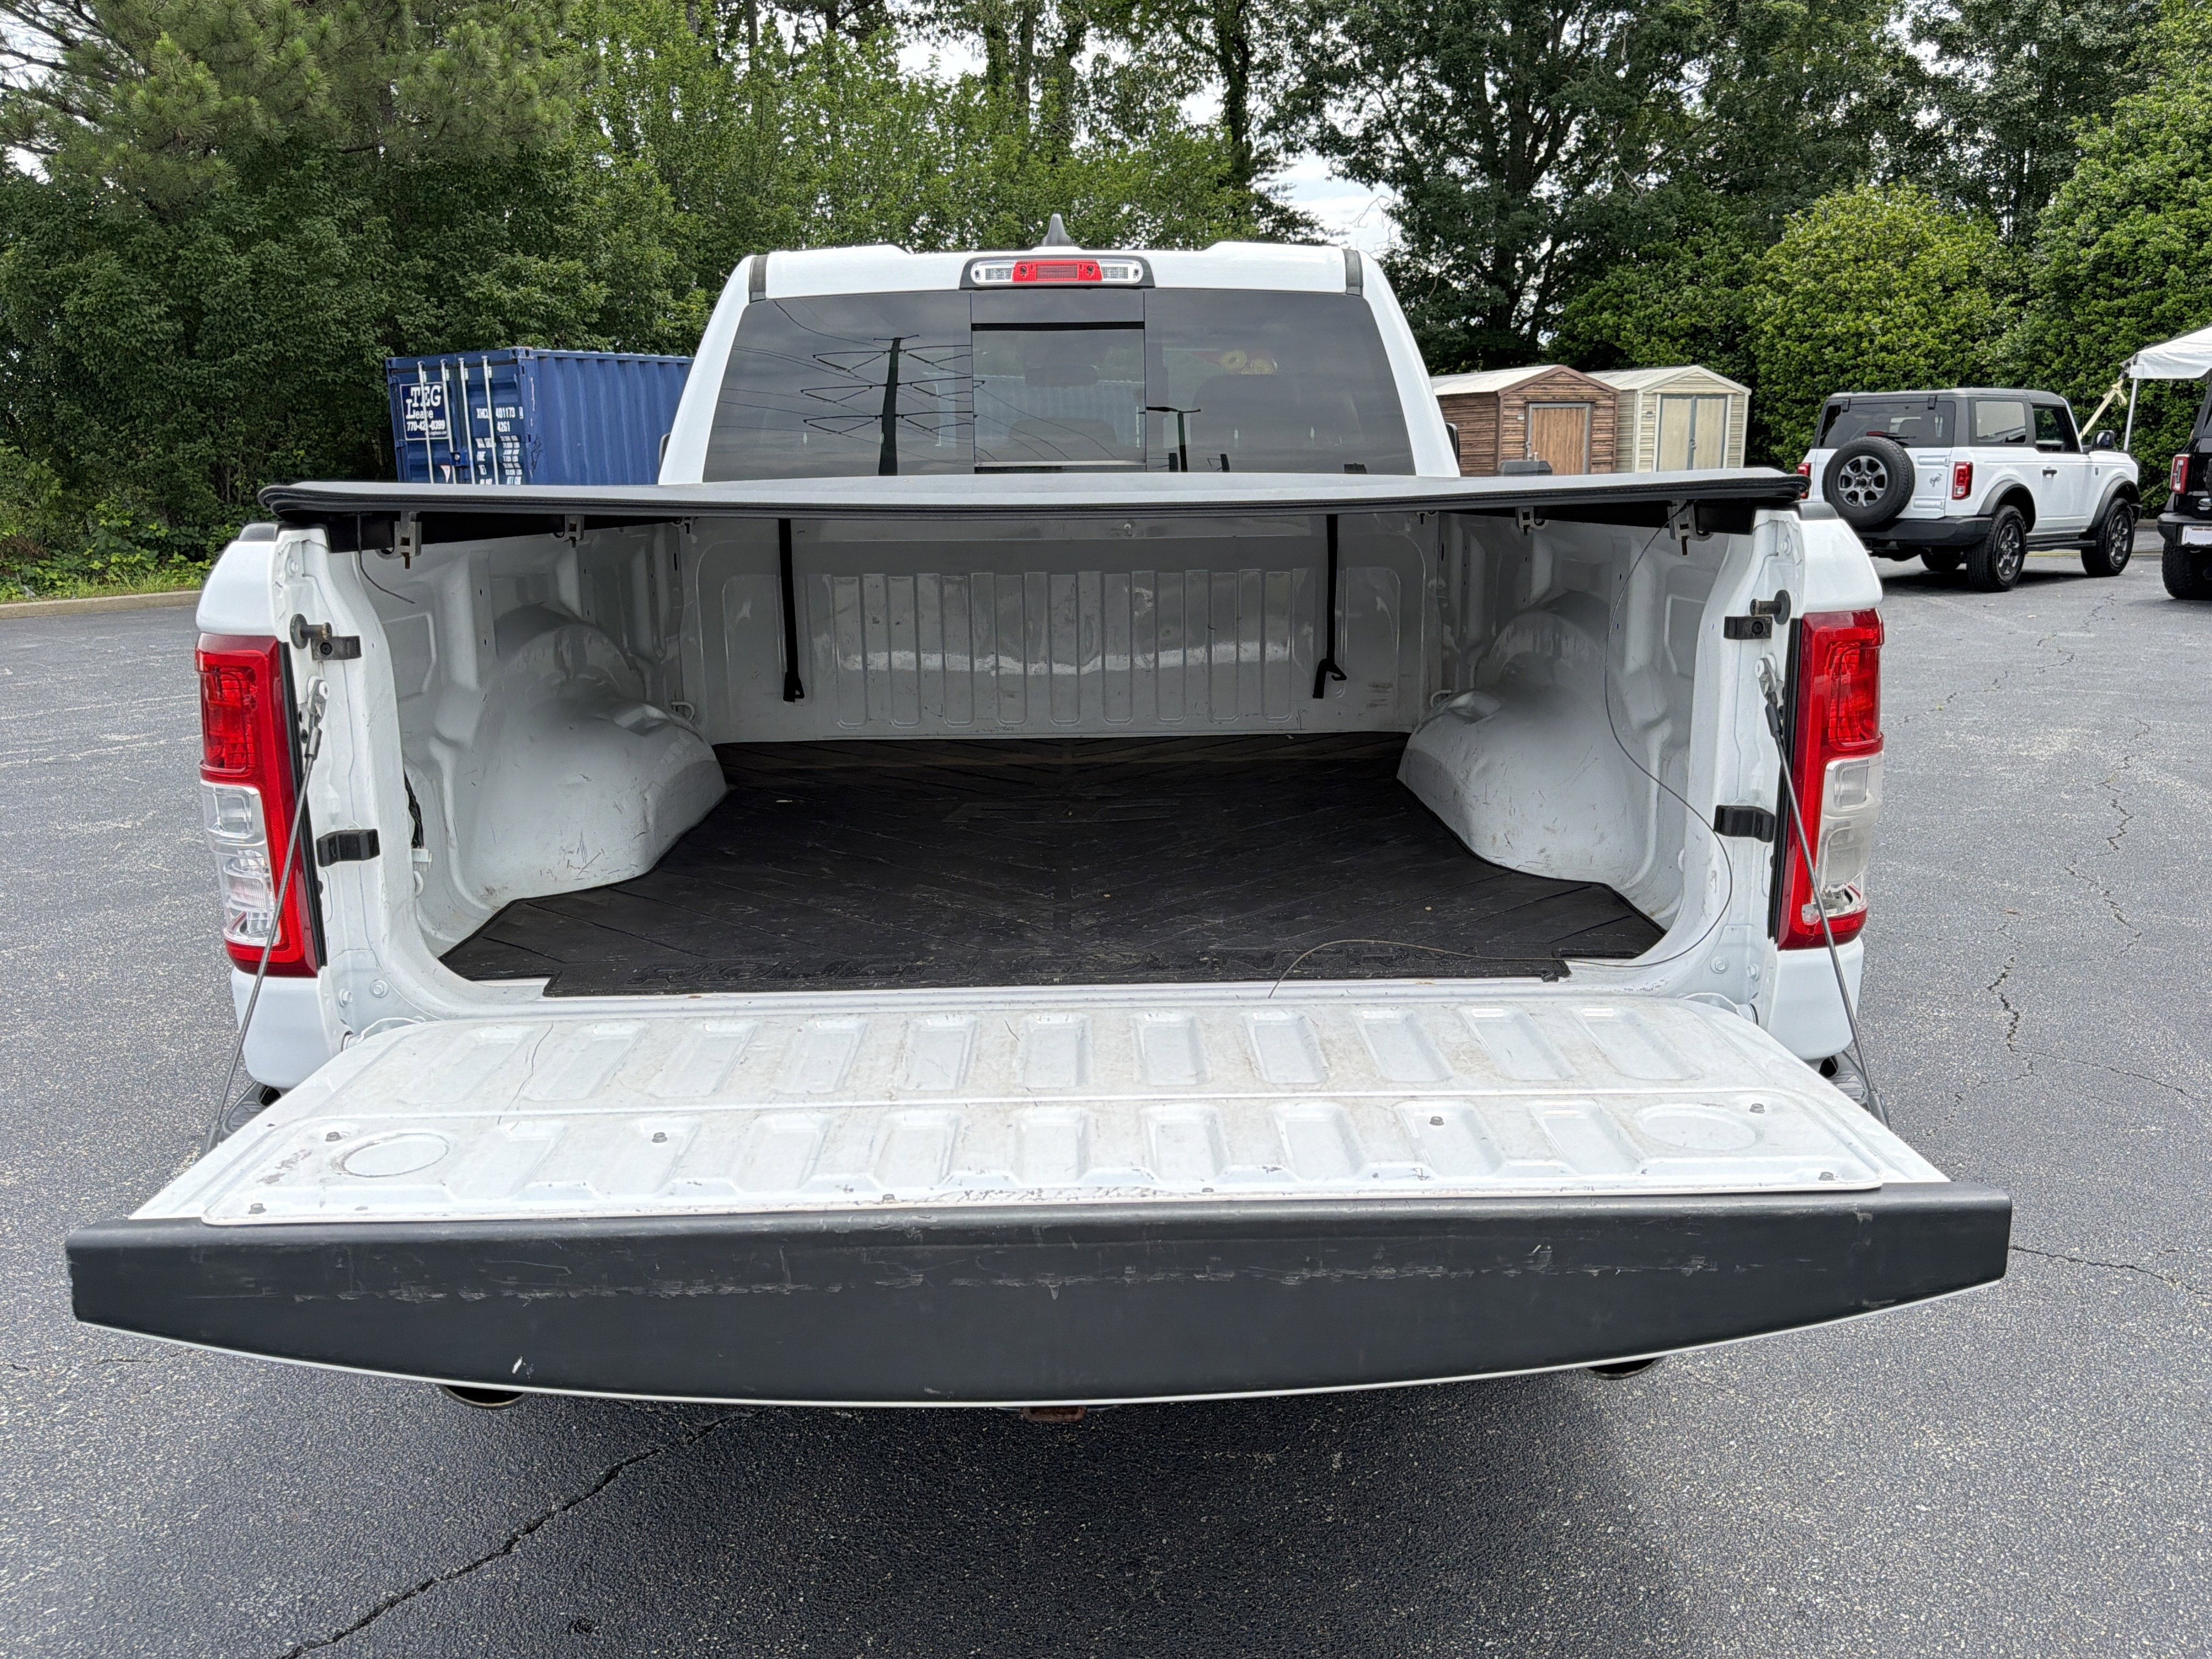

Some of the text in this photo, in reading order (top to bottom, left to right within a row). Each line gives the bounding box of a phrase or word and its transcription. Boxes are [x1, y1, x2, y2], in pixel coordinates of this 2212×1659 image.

[410, 385, 442, 407] TEG
[406, 399, 433, 419] Leae
[407, 419, 445, 432] 770-42-0399
